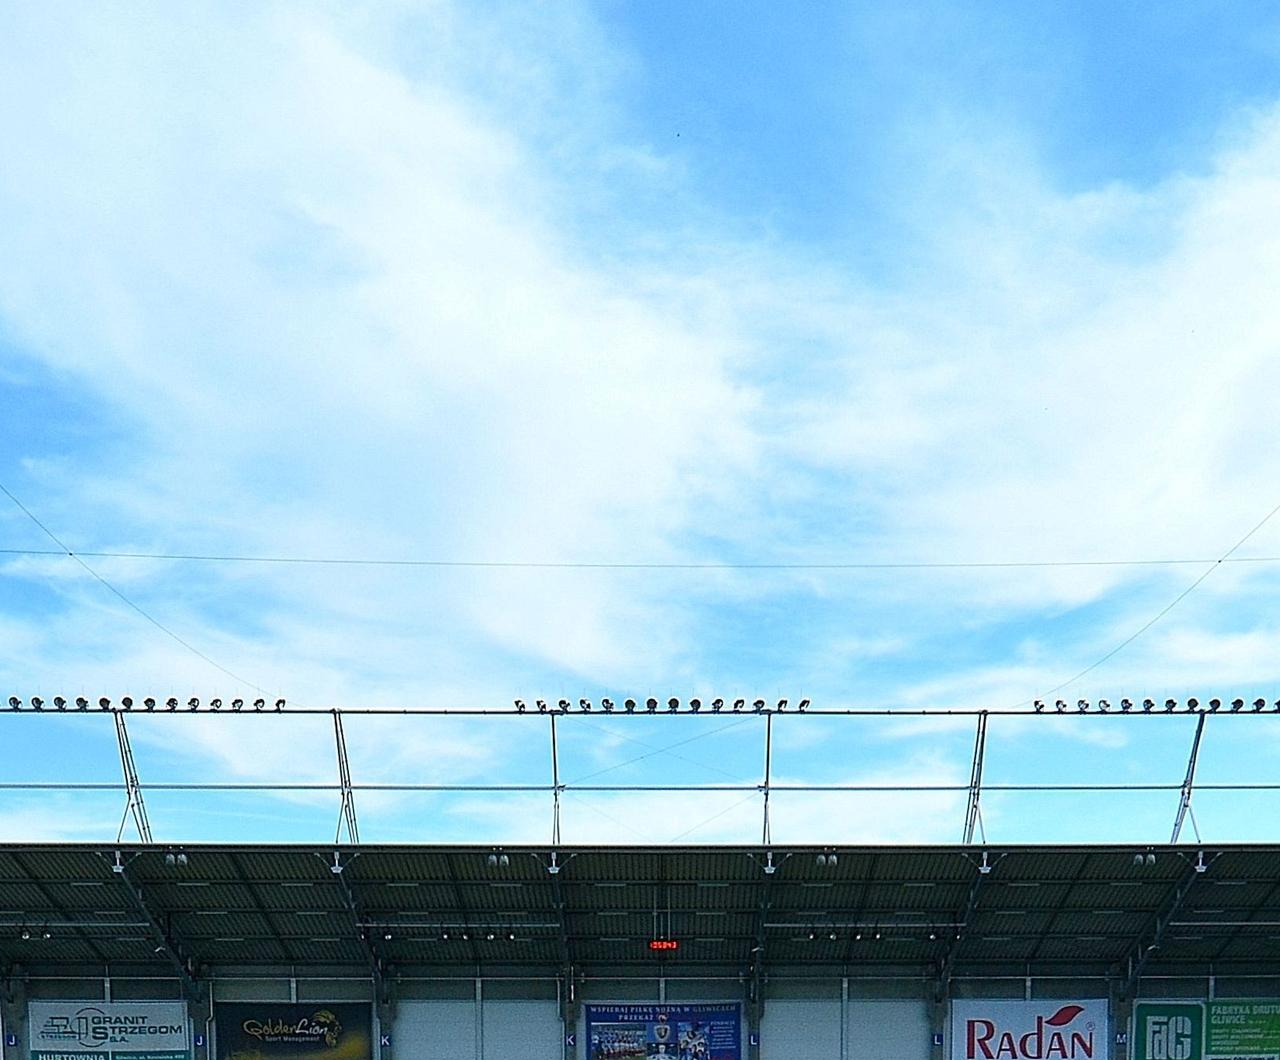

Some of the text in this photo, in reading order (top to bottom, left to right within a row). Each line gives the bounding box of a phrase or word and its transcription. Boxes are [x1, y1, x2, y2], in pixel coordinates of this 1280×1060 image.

[1211, 1005, 1250, 1015] FABRYKA
[91, 1016, 148, 1025] GRANIT
[1211, 1015, 1246, 1024] GLIWICE
[92, 1025, 183, 1040] STRZEGOM
[243, 1018, 328, 1041] GoldenLion
